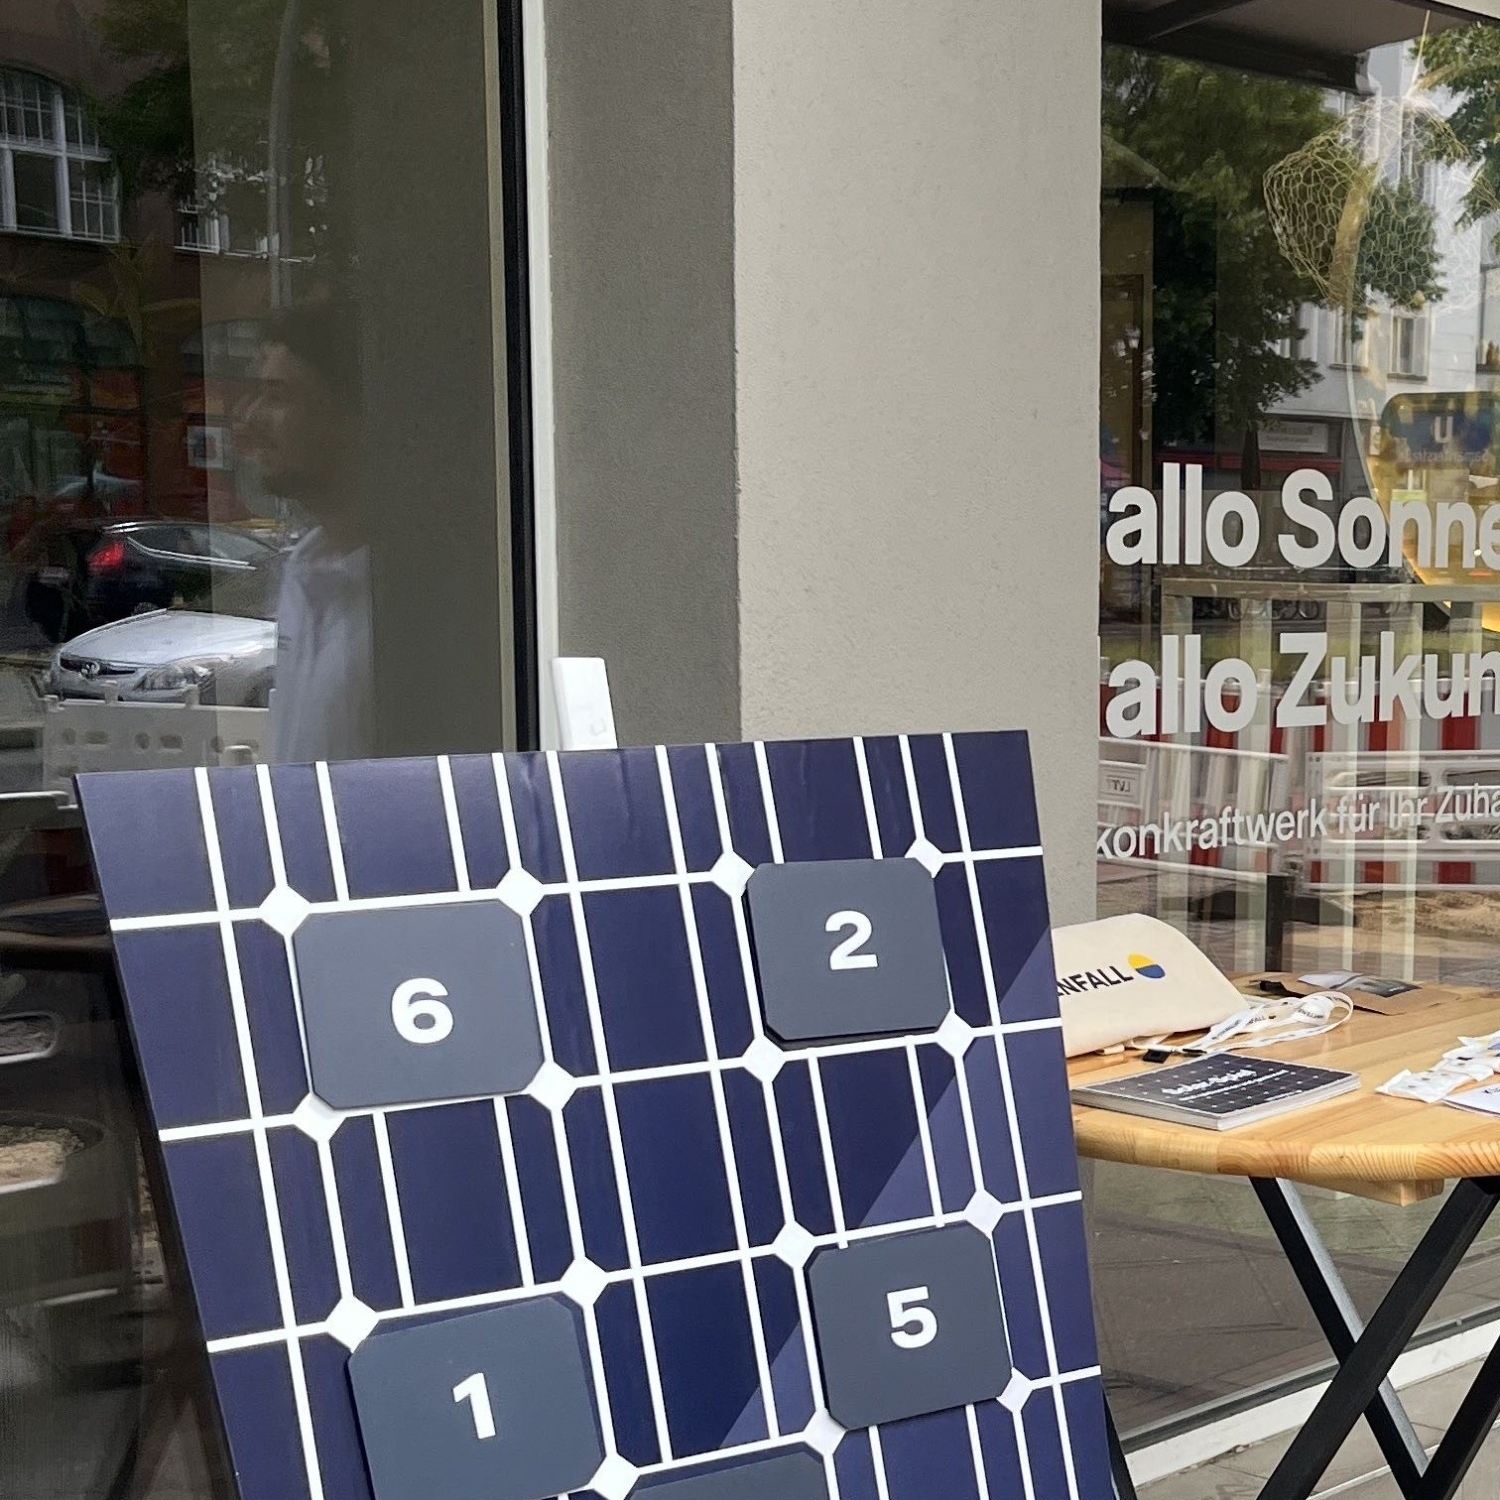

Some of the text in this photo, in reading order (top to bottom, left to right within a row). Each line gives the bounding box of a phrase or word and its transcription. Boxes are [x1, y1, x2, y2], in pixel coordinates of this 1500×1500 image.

[1337, 797, 1380, 834] für
[1388, 795, 1428, 829] Ihr
[826, 911, 879, 970] 2
[1056, 965, 1134, 996] NFALL
[392, 978, 454, 1046] 6
[886, 1286, 938, 1348] 5
[452, 1373, 496, 1440] 1
